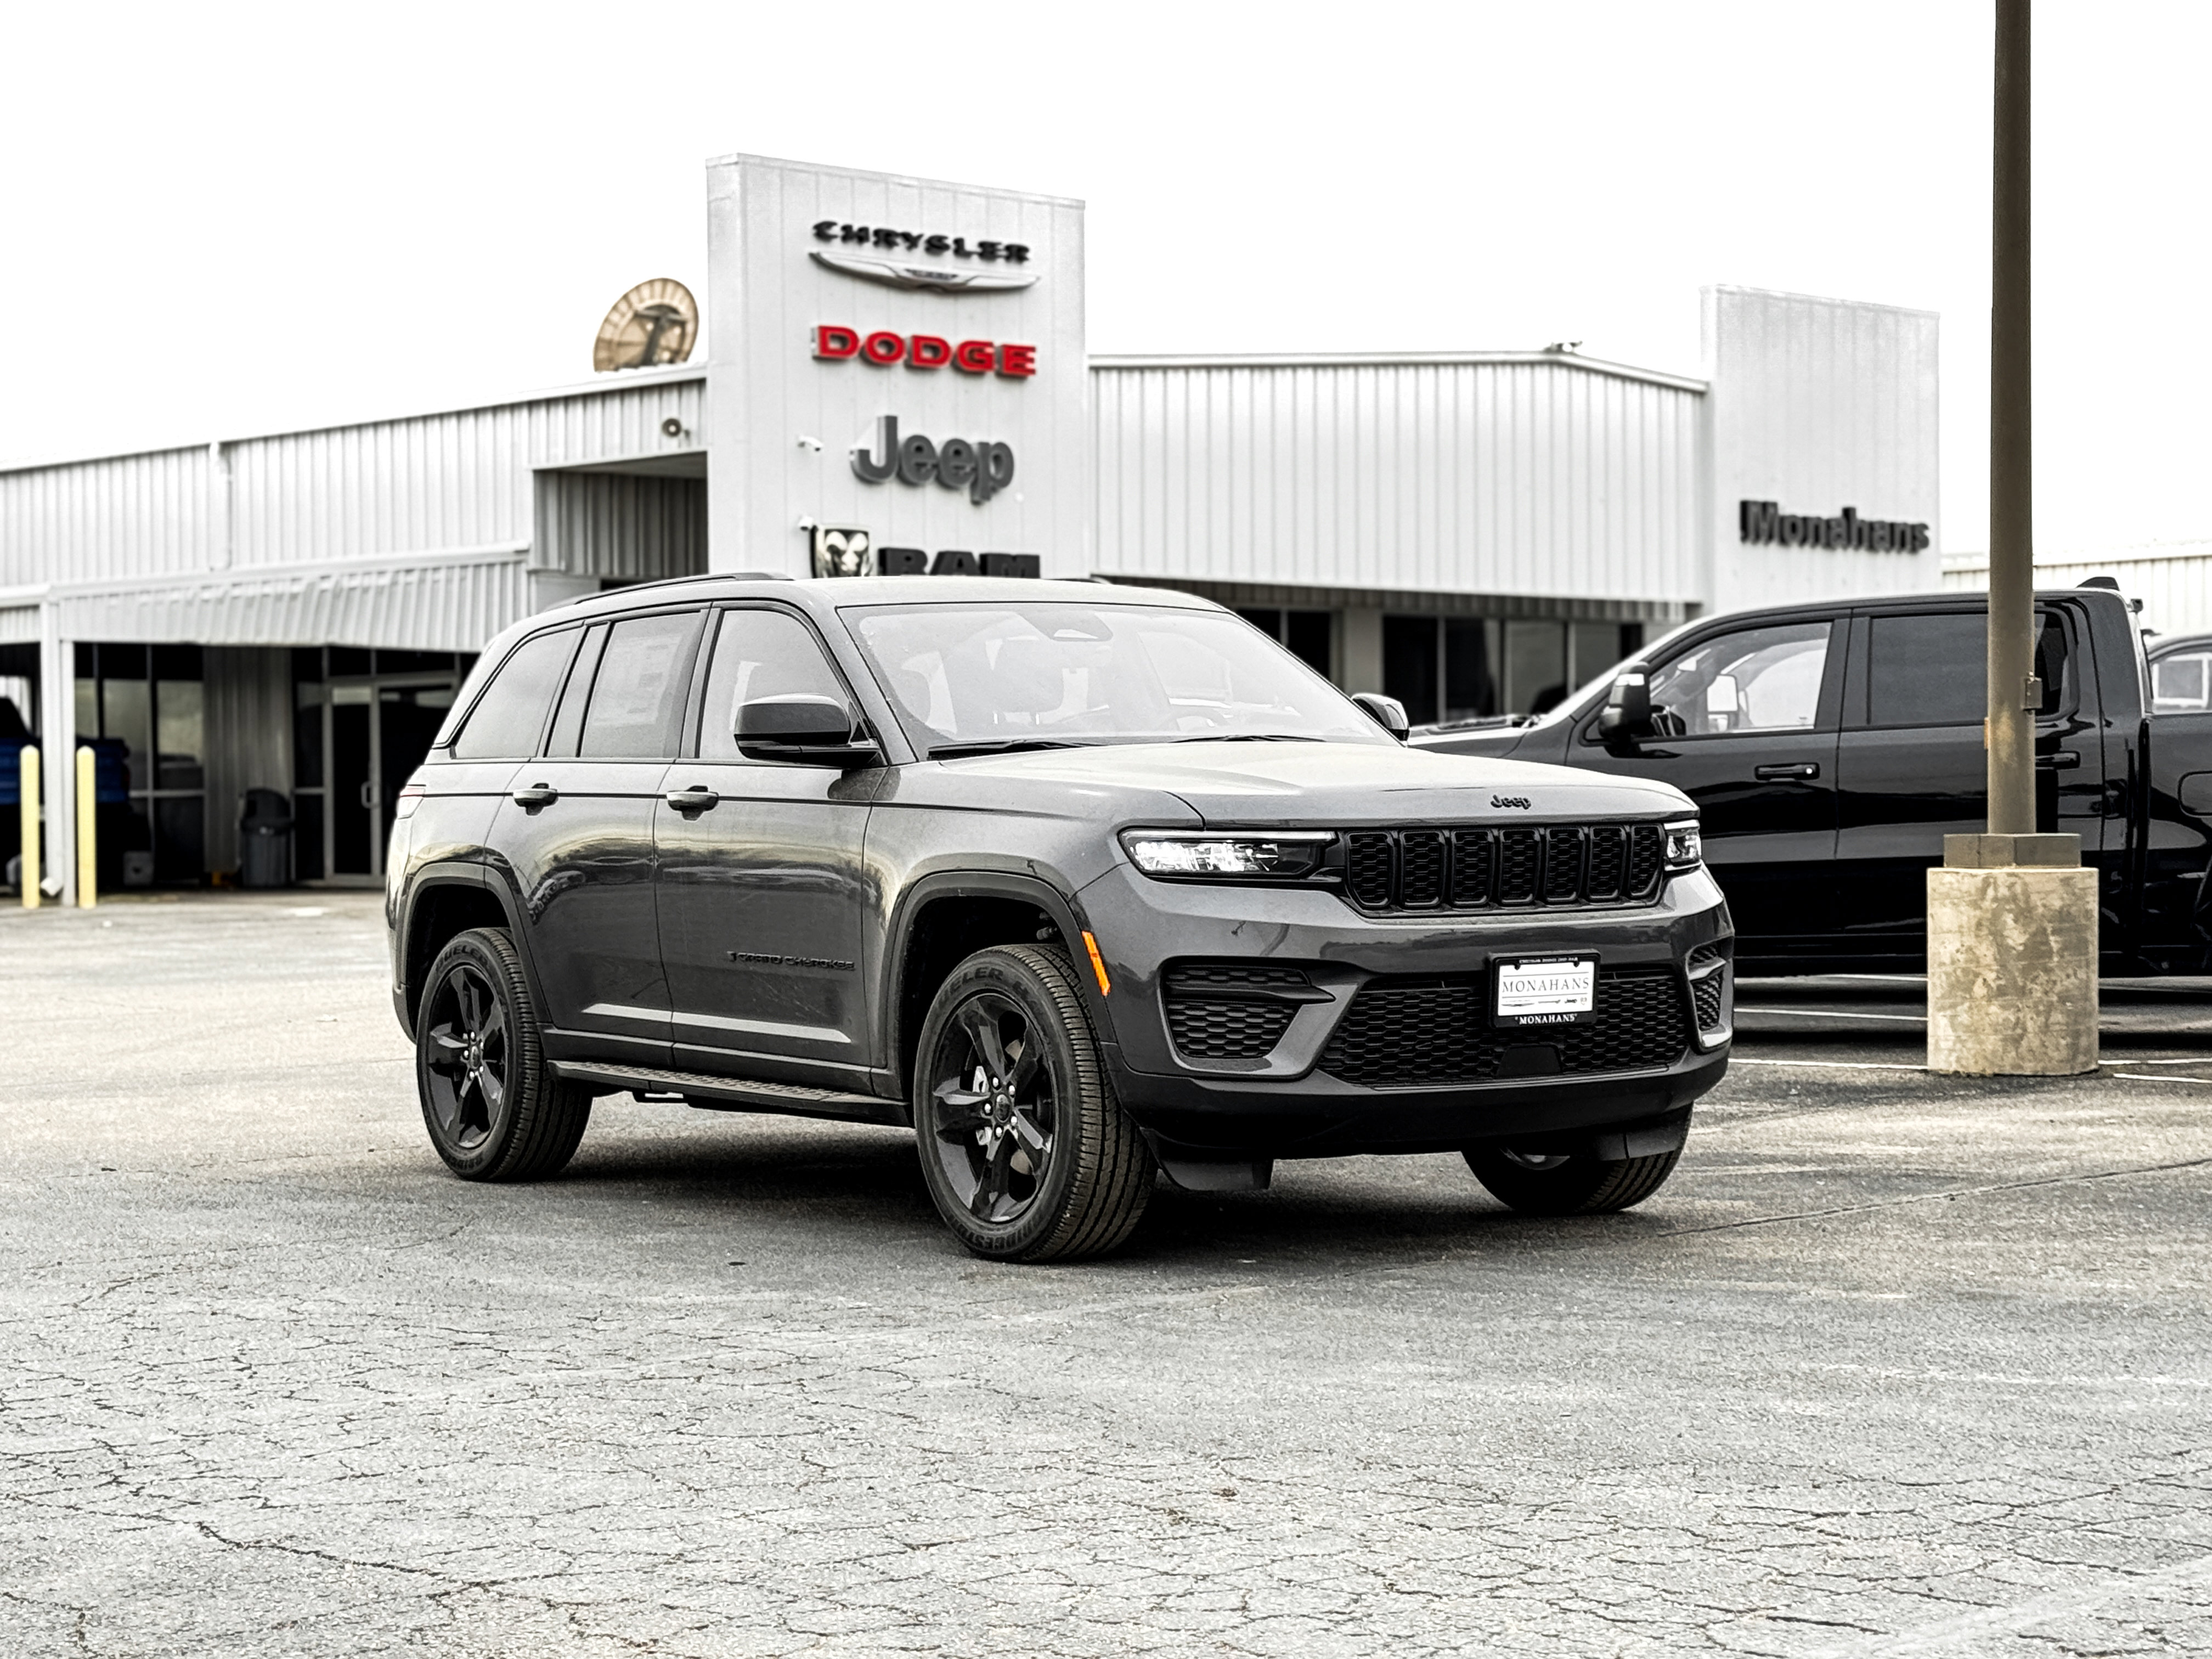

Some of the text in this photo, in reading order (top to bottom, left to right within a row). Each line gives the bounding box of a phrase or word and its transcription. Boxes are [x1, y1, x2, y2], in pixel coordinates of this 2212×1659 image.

[812, 221, 1030, 264] CHRYSLER
[812, 325, 1036, 382] DODGE
[850, 415, 1014, 505] Jeep
[1740, 500, 1929, 555] Monahans
[878, 547, 1040, 578] RAM
[1491, 794, 1531, 810] Jeep
[1502, 978, 1589, 993] MONAHANS
